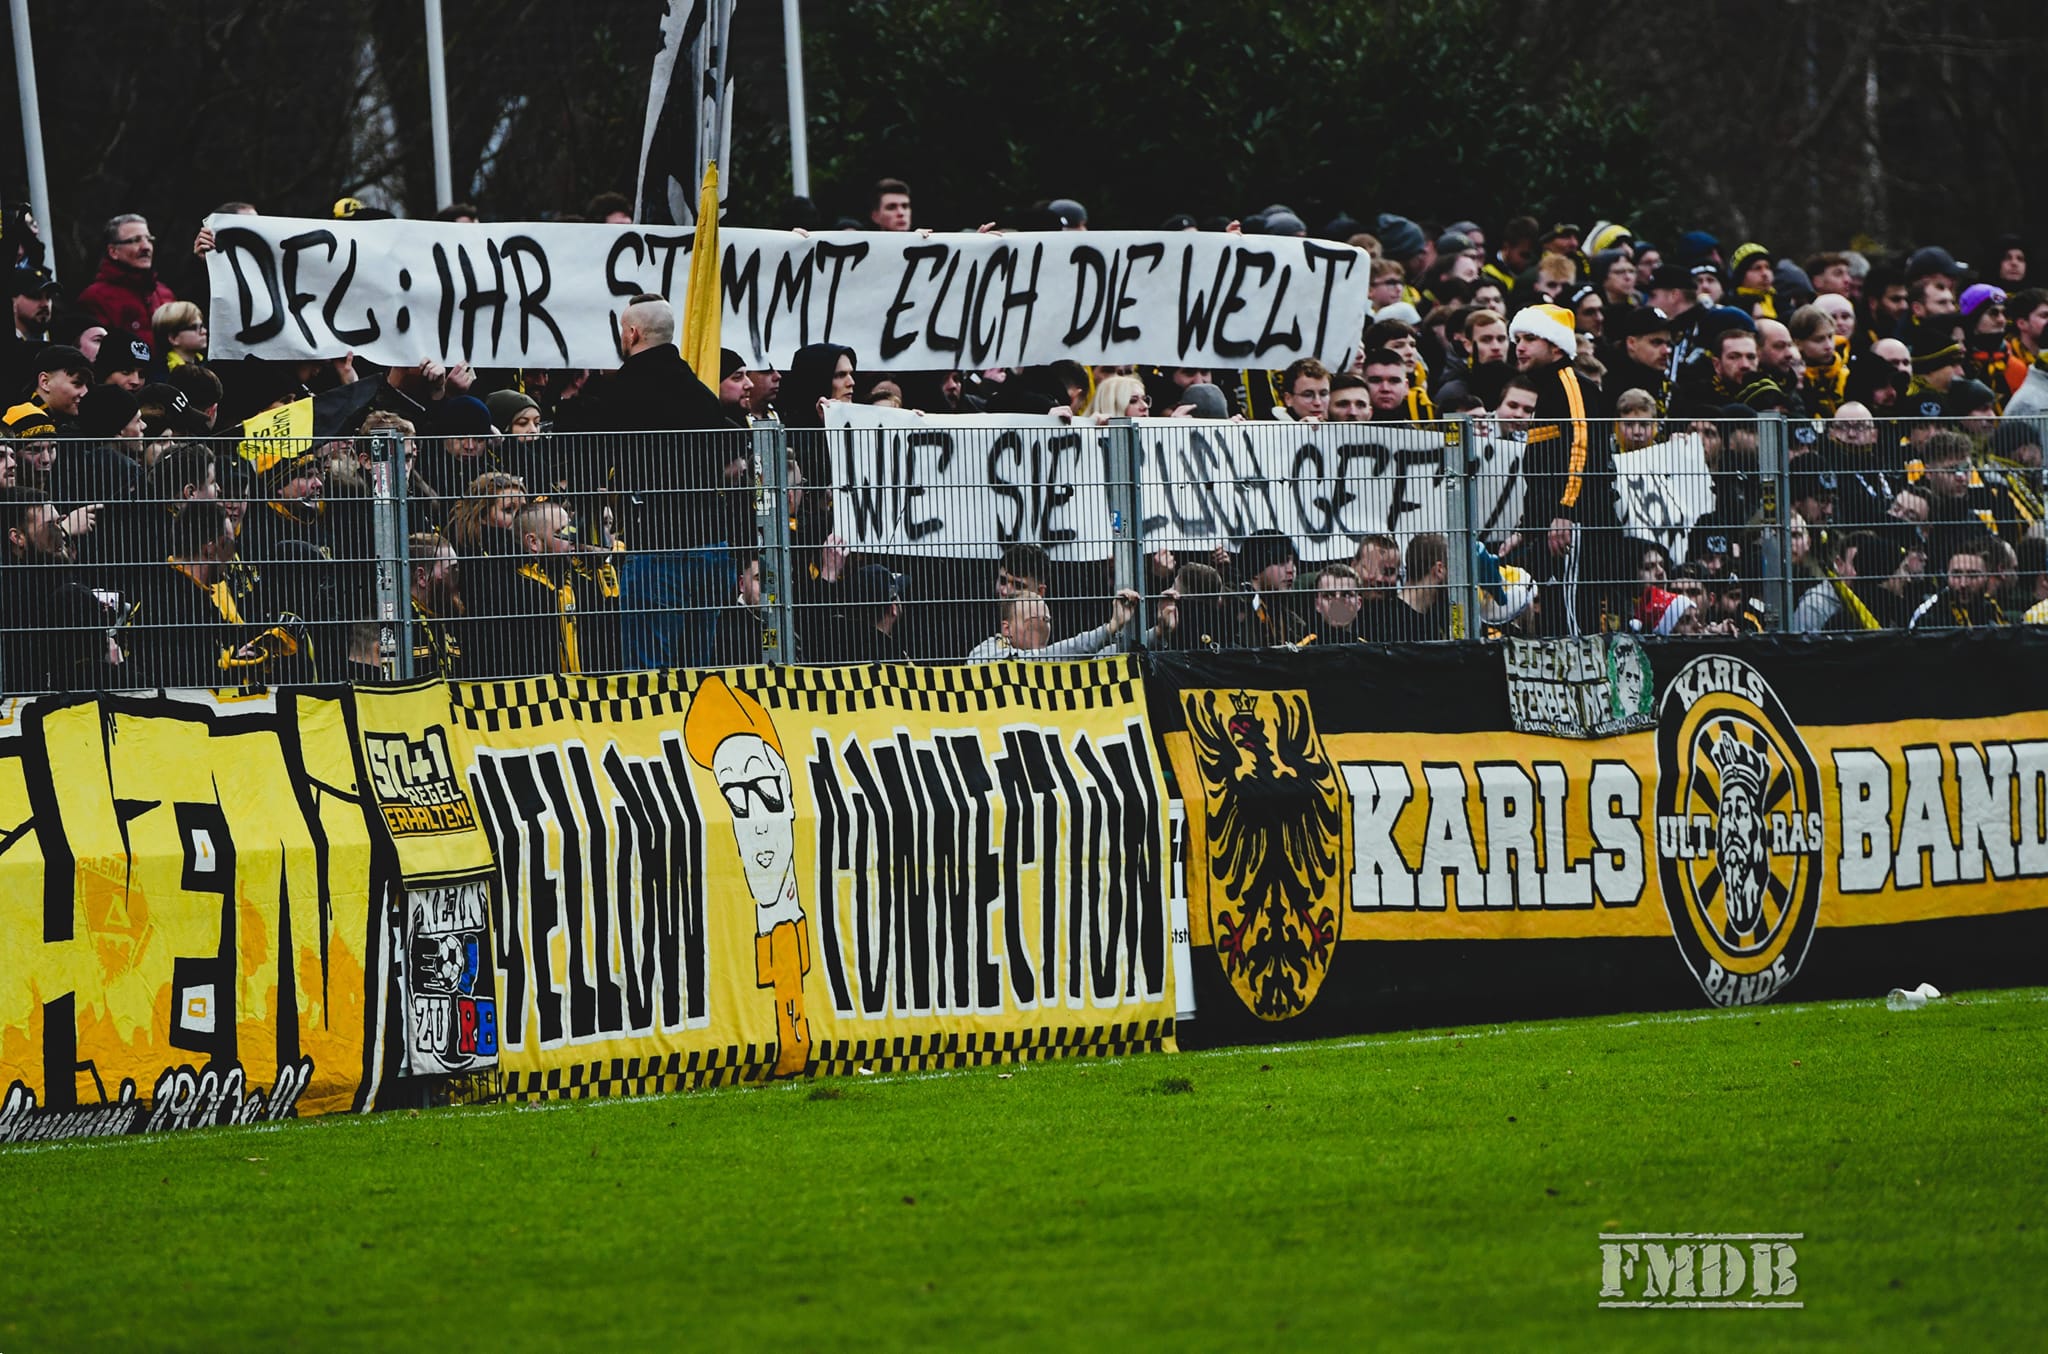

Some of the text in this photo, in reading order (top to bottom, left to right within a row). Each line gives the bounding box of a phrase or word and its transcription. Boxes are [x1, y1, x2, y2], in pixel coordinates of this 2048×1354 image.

[432, 236, 570, 367] IHR
[606, 231, 869, 364] STMMT
[880, 241, 1042, 368] EUCH
[1063, 243, 1164, 350] DIE
[843, 422, 954, 542] WIE
[988, 431, 1081, 546] SIE
[1675, 658, 1764, 712] KARLS
[383, 800, 473, 832] ERHALTEN!
[404, 780, 463, 807] REGEL
[1340, 762, 1645, 910] KARLS
[466, 716, 1166, 1050] YELLOW CONNECTION
[1705, 953, 1790, 1007] BANDE
[414, 998, 498, 1056] ZU RB
